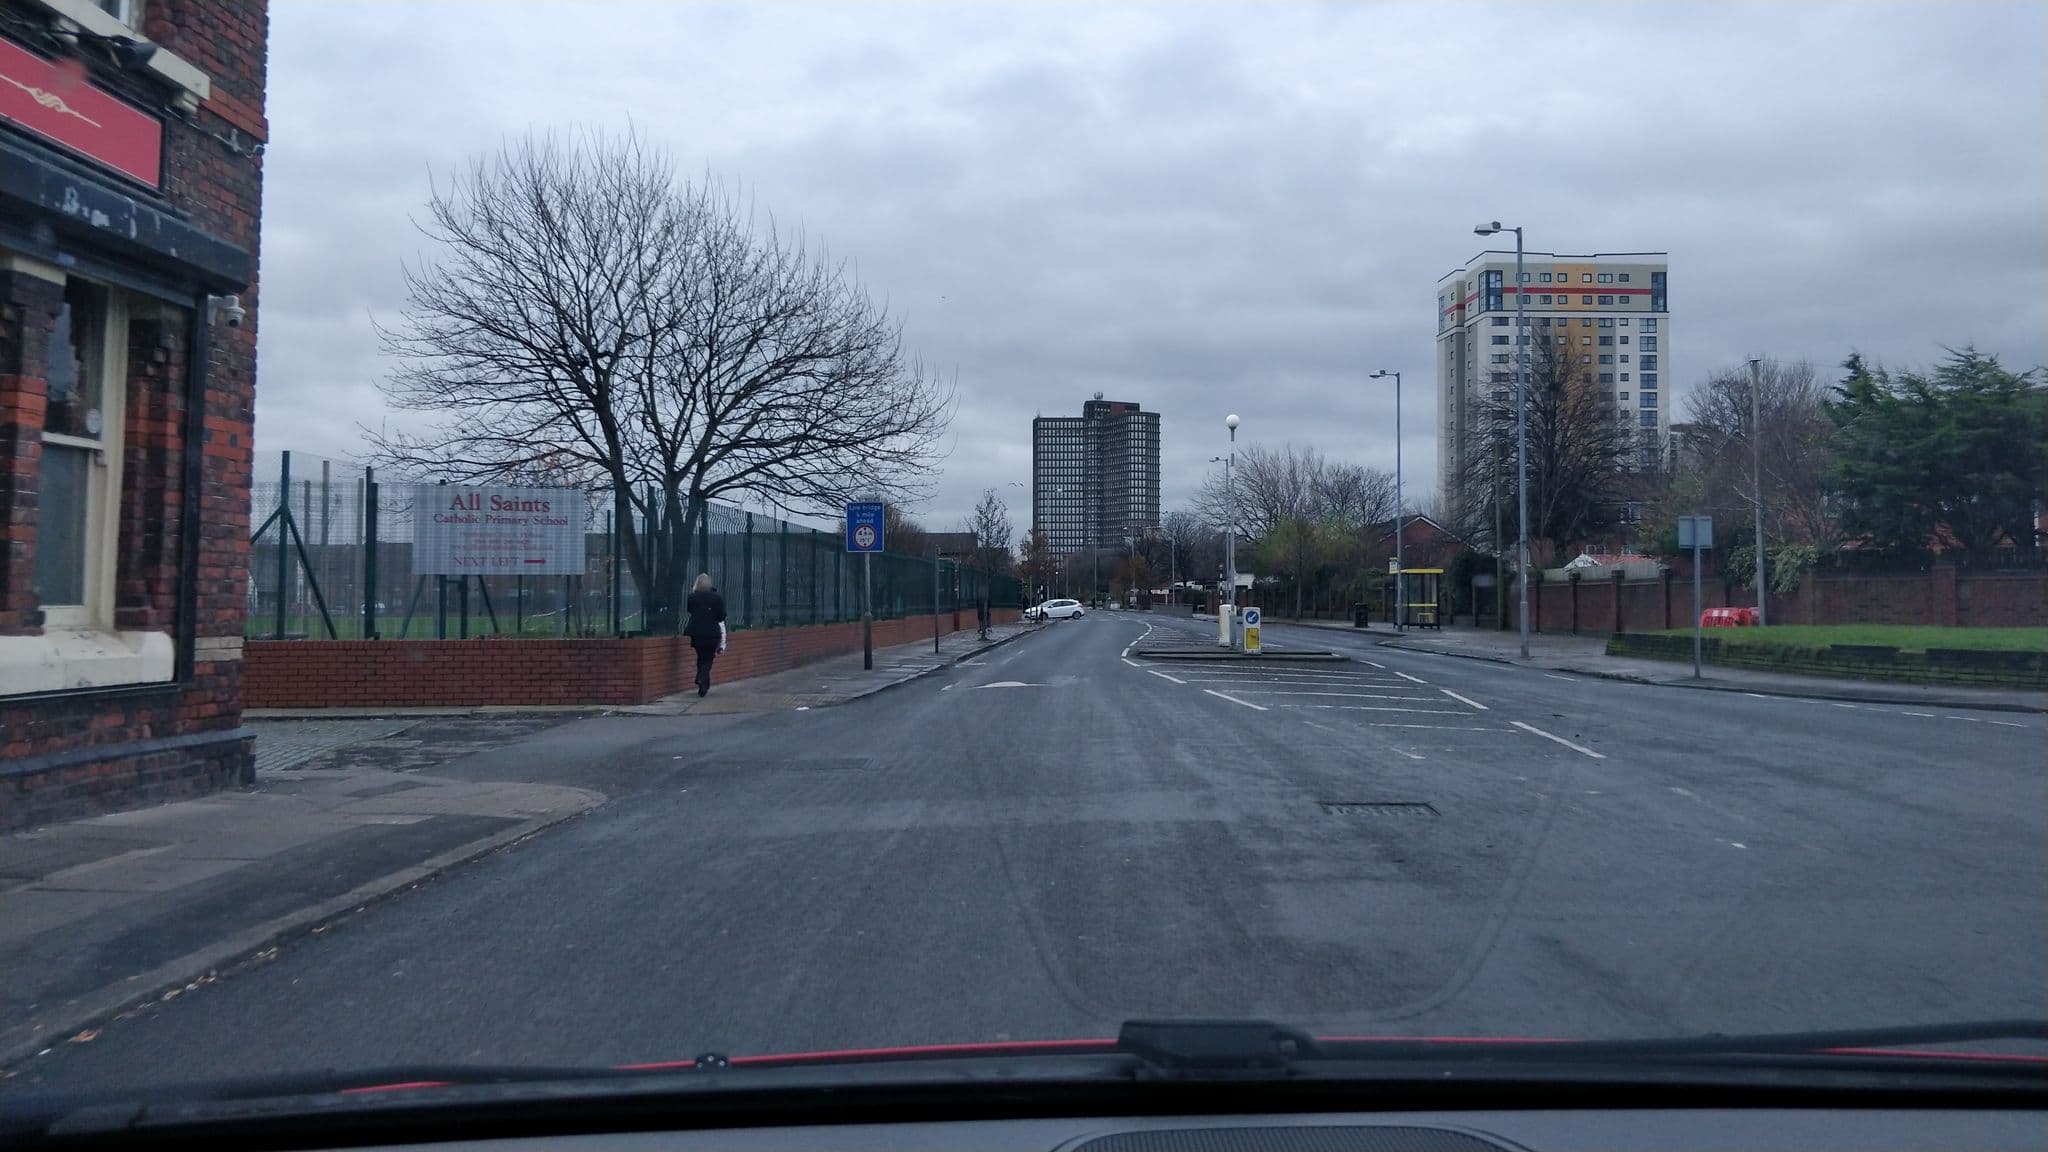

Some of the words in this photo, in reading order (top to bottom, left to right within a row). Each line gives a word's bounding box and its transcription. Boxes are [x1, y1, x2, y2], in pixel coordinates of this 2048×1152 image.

[449, 492, 481, 511] All
[490, 494, 551, 513] Saints
[433, 513, 480, 524] Catholic
[485, 514, 529, 526] Primary
[532, 515, 569, 526] School
[453, 556, 486, 567] NEXT
